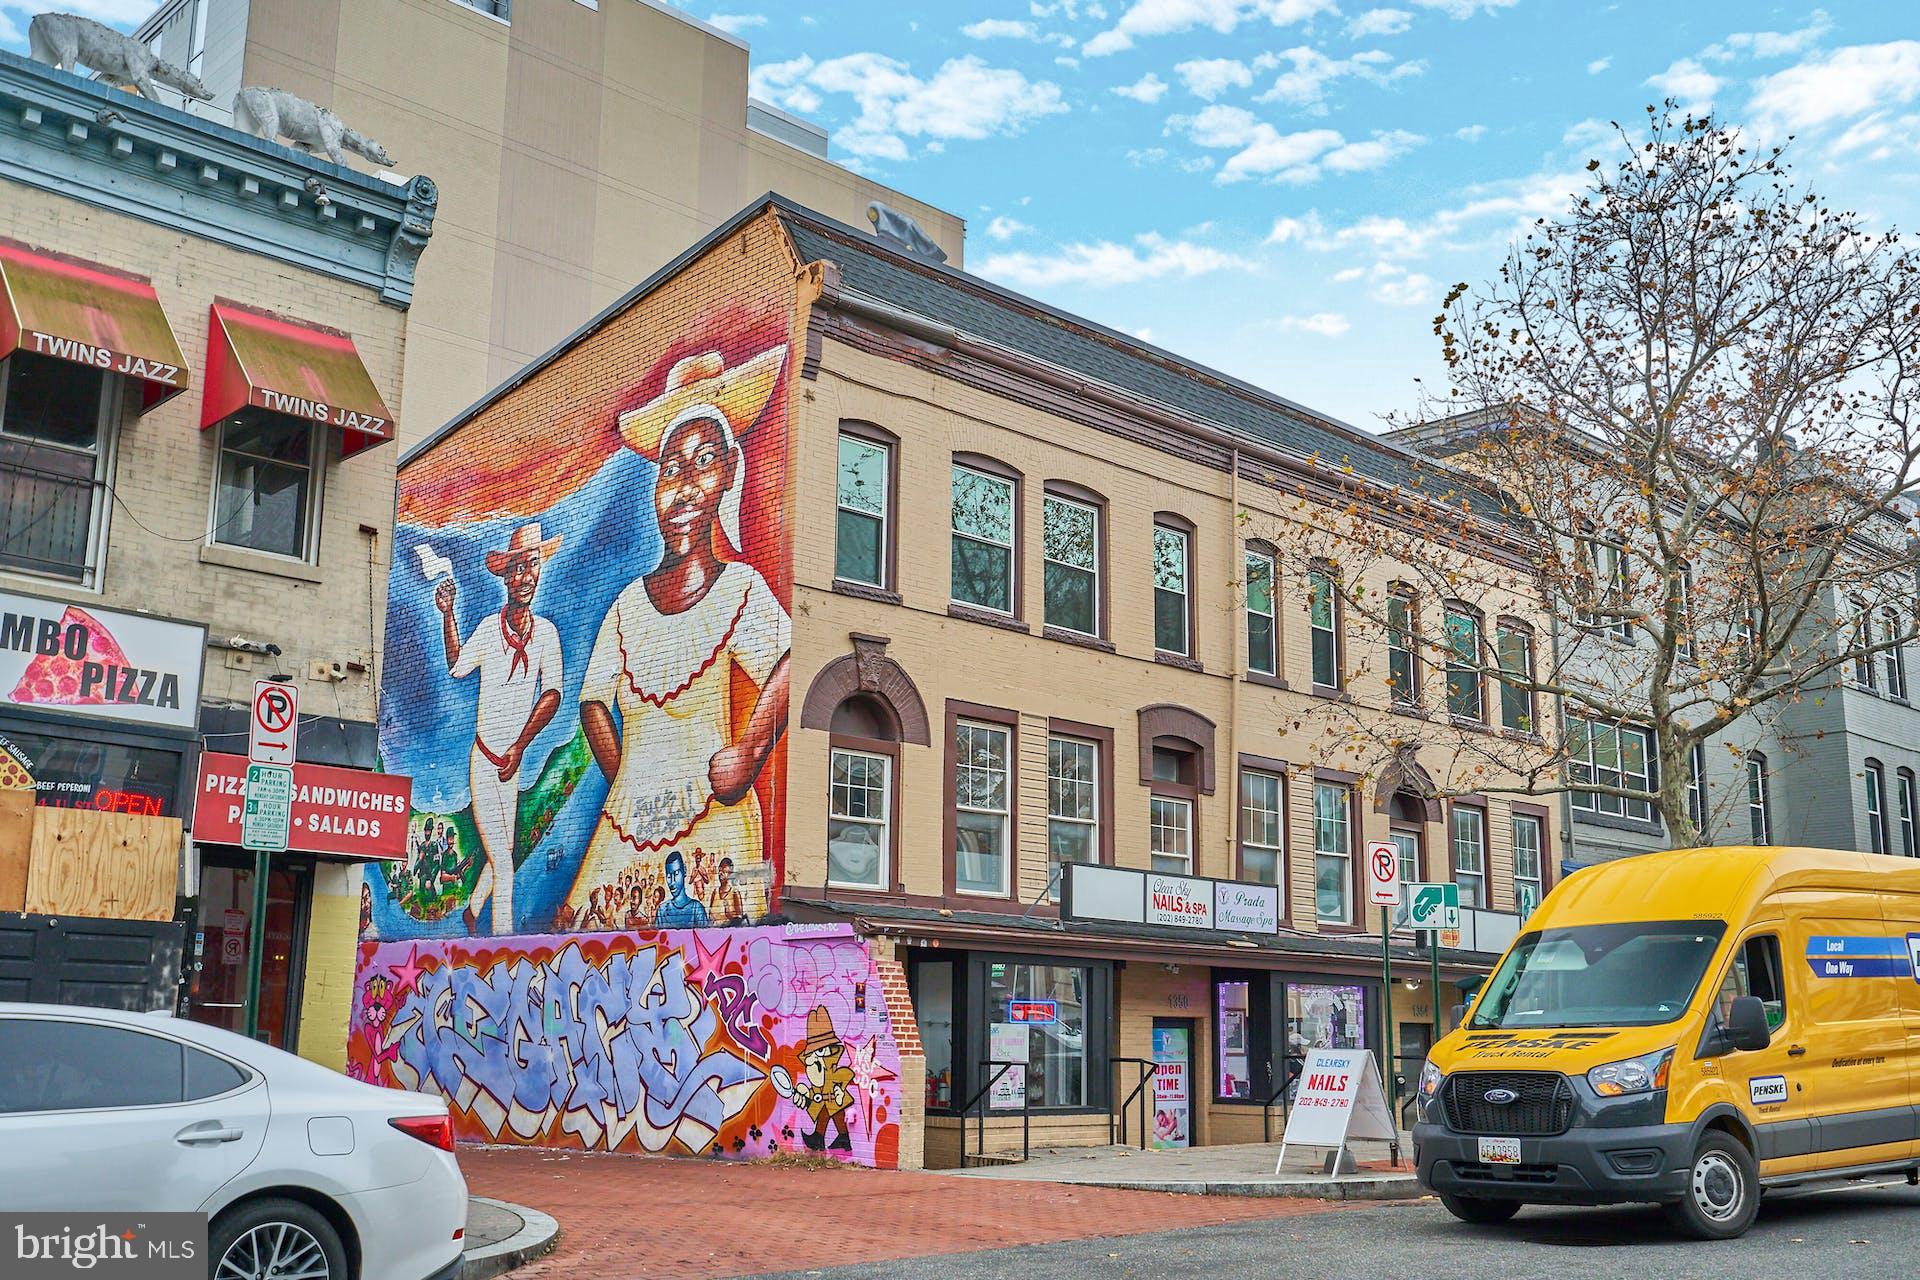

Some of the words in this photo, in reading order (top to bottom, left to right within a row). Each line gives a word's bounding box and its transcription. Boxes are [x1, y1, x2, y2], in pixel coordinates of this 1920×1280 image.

[32, 331, 112, 369] TWINS
[117, 355, 178, 385] JAZZ
[261, 389, 329, 422] TWINS
[333, 409, 385, 436] JAZZ
[0, 611, 89, 661] MBO
[79, 661, 180, 710] PIZZA
[7, 744, 34, 770] SAUSAGE
[252, 770, 259, 782] 2
[261, 770, 283, 779] HOUR
[260, 778, 287, 788] PARKING
[36, 780, 56, 791] BEEF
[57, 782, 92, 793] PEPERONI
[95, 789, 164, 817] OPEN
[263, 802, 281, 810] HOUR
[291, 783, 406, 814] SANDWICHES
[260, 809, 286, 818] PARKING
[308, 814, 381, 839] SALADS
[1153, 877, 1174, 895] Clear
[1175, 879, 1192, 900] Sky
[1153, 892, 1183, 913] NAILS
[1185, 901, 1191, 914] &
[1192, 902, 1208, 917] SPA
[1233, 890, 1266, 908] Prada
[1156, 912, 1174, 923] (202)
[1174, 914, 1204, 925] 849-2780
[1218, 910, 1256, 928] Massage
[1256, 911, 1274, 929] Spa
[1826, 939, 1845, 952] Local
[1825, 961, 1839, 975] One
[1839, 961, 1854, 977] Way
[703, 969, 770, 1062] DC
[1011, 1003, 1055, 1021] OPEN
[1456, 1039, 1599, 1052] PENSKE
[1472, 1050, 1504, 1059] Truck
[1508, 1050, 1556, 1059] Rental
[1154, 1064, 1182, 1076] open
[1316, 1058, 1351, 1068] CLEARSKY
[1156, 1078, 1179, 1091] TIME
[1307, 1073, 1349, 1092] NAILS
[1753, 1083, 1784, 1097] PENSKE
